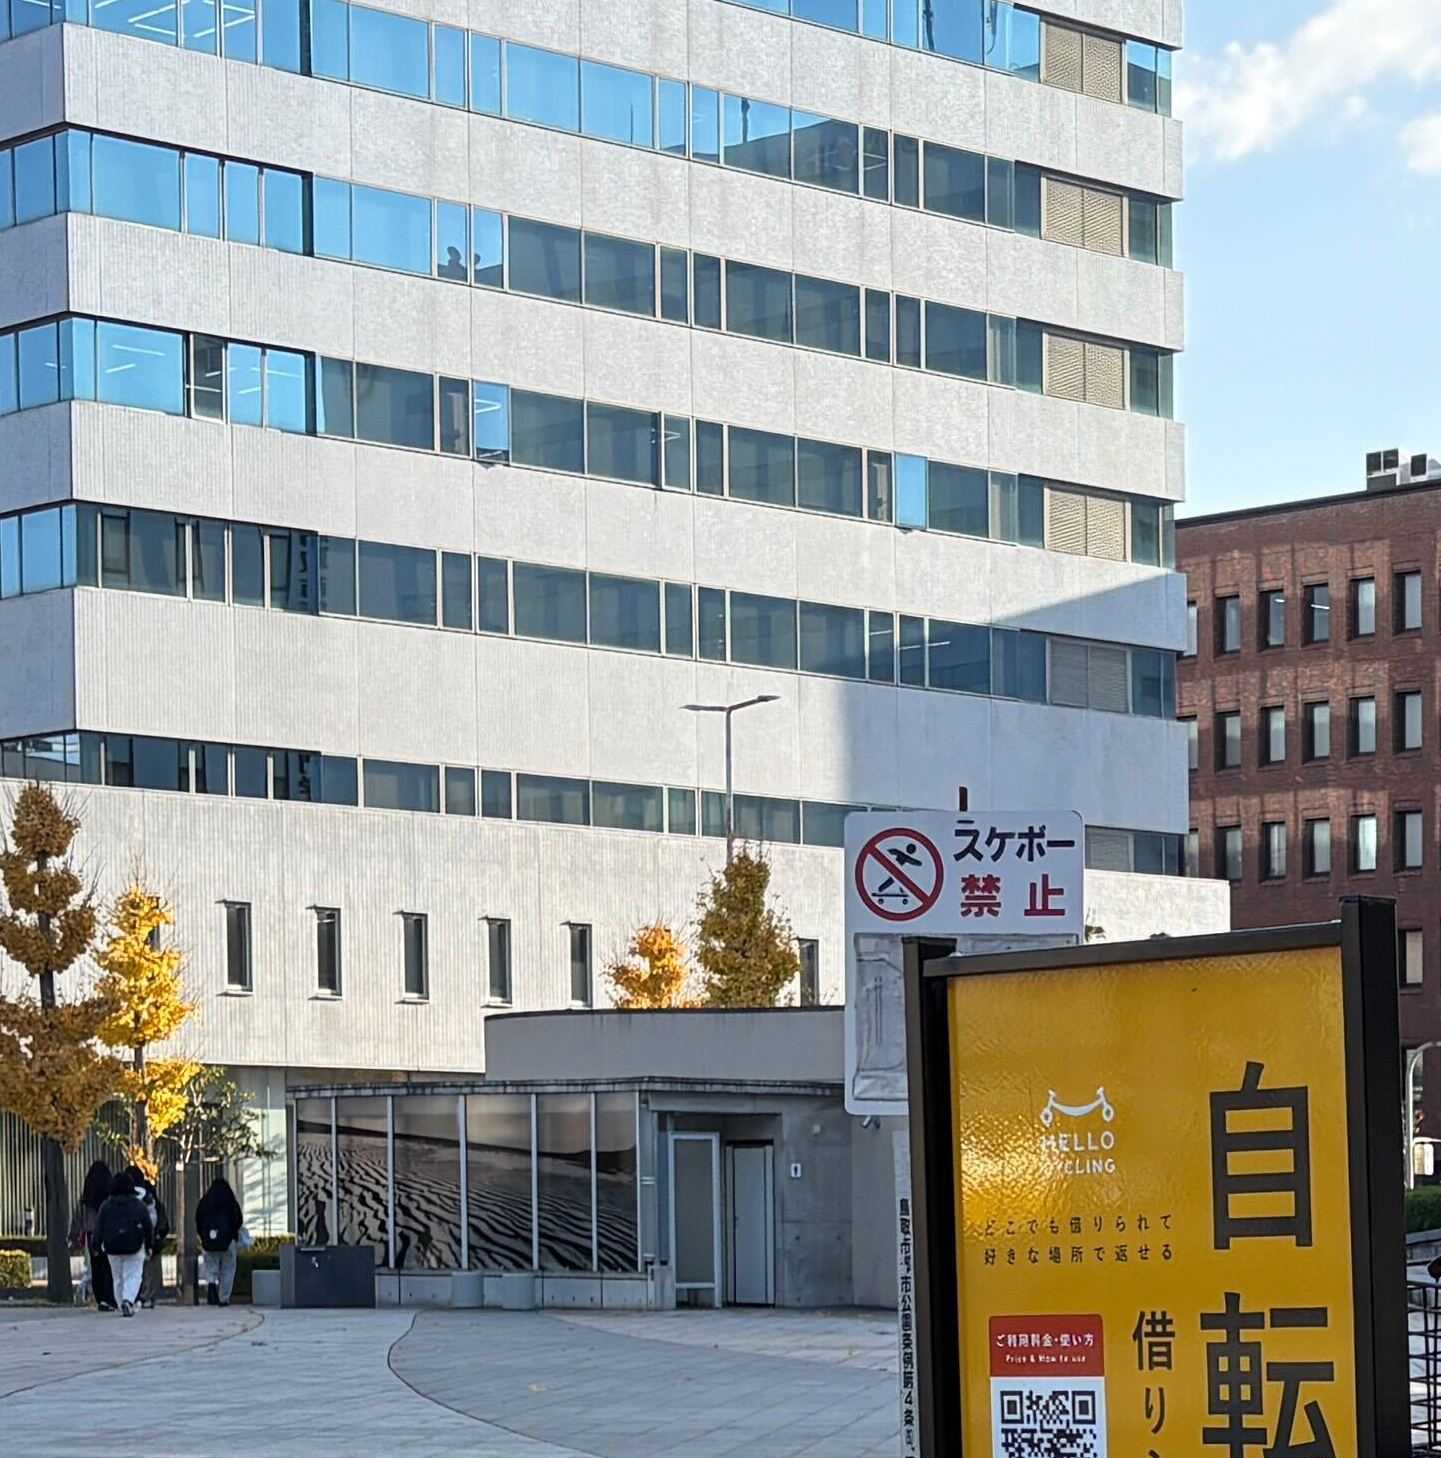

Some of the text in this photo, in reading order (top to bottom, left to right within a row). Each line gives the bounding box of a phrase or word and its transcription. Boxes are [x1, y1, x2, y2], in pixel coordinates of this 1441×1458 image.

[953, 822, 1075, 862] スケボー
[960, 874, 1066, 917] 禁止
[1041, 1131, 1115, 1152] HELLO
[985, 1213, 1173, 1237] どこでも借りられて
[984, 1243, 1173, 1266] 好きな場所で返せる
